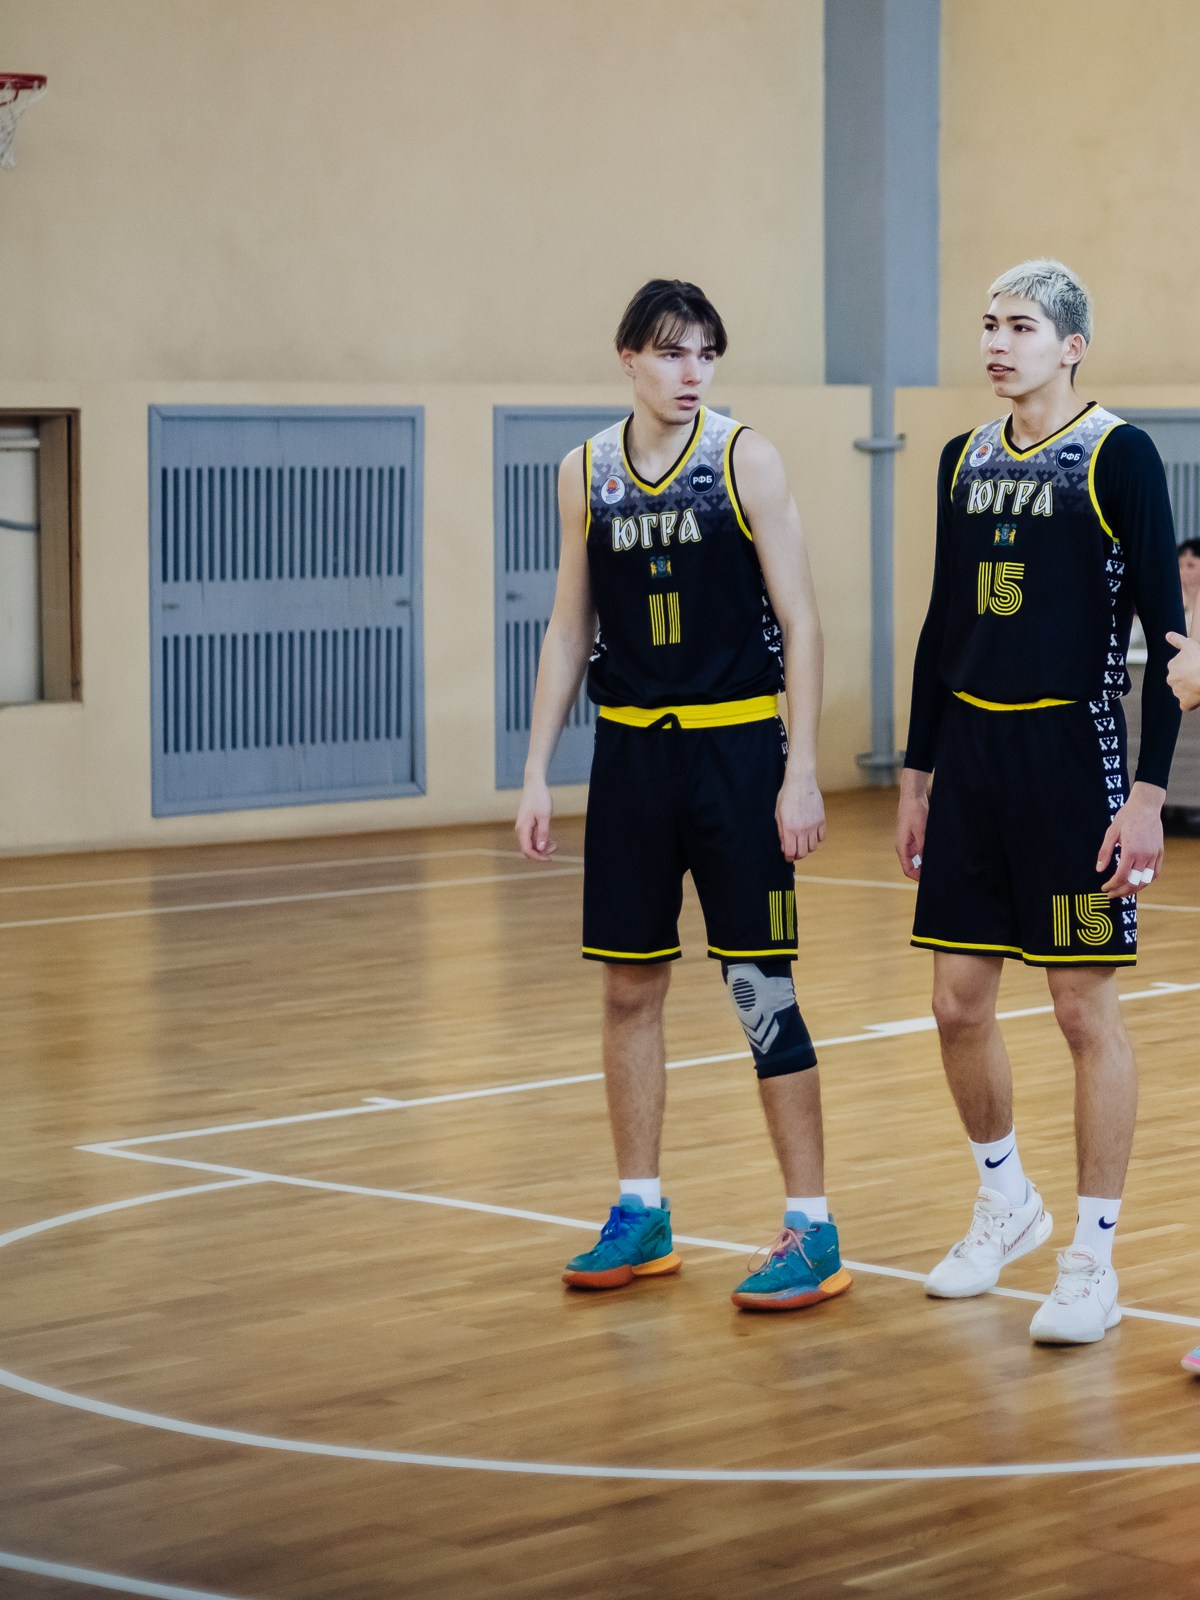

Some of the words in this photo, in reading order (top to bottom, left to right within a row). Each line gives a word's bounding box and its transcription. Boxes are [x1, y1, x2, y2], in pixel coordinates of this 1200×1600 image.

[693, 475, 713, 485] РФБ
[966, 479, 1053, 517] ЮГРА
[612, 508, 702, 552] ЮГРА
[977, 561, 1025, 616] 15
[649, 591, 681, 646] 11
[1052, 892, 1114, 948] 15
